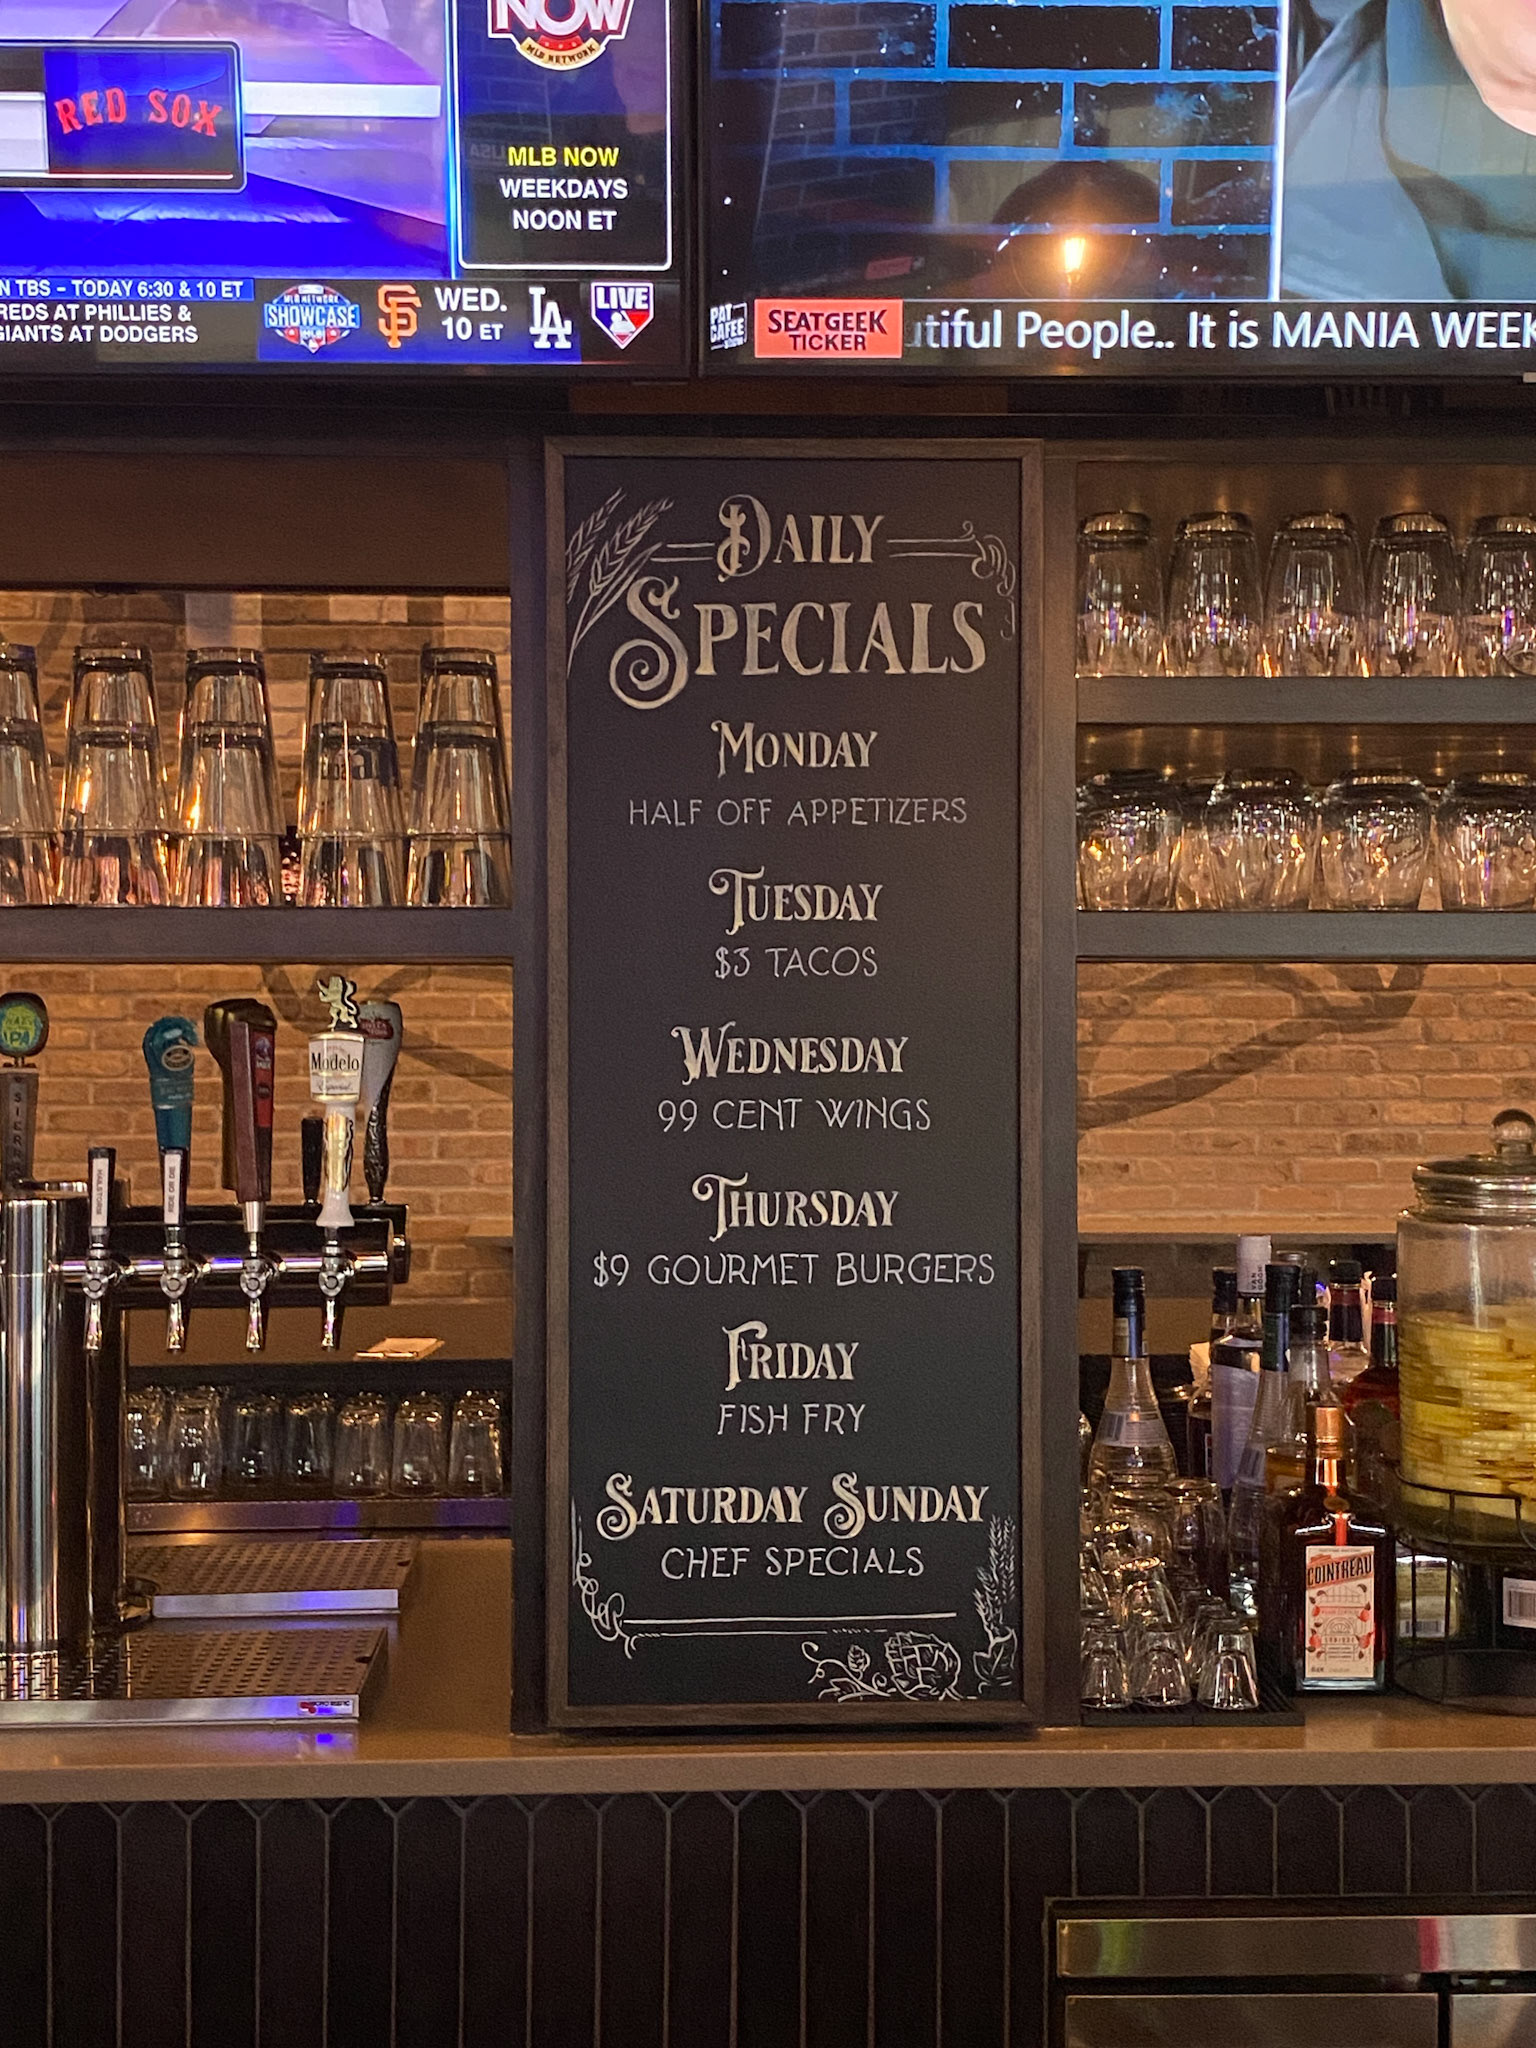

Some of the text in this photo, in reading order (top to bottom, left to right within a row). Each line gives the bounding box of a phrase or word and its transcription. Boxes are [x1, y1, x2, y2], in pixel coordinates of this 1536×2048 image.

[497, 0, 625, 36] NOW
[54, 87, 222, 137] RED SOX
[508, 146, 619, 167] MLB NOW
[499, 178, 628, 199] WEEKDAYS
[512, 209, 617, 230] NOON ET
[15, 279, 51, 297] TBS
[72, 280, 133, 297] TODAY
[137, 280, 174, 297] 6:30
[179, 281, 191, 297] &
[196, 281, 216, 297] 10
[221, 281, 243, 297] ET
[434, 287, 507, 312] WED.
[596, 286, 649, 309] LIVE
[0, 303, 191, 321] REDS AT PHILLIES &
[268, 304, 356, 327] SHOWCASE
[529, 287, 572, 349] LA
[711, 303, 733, 324] PAT
[768, 309, 888, 335] SEATGEEK
[68, 325, 94, 342] AT
[100, 325, 198, 343] DODGERS
[441, 317, 504, 340] 10 ET
[789, 334, 866, 351] TICKER
[1017, 309, 1175, 359] People..
[1188, 311, 1216, 349] It
[1228, 309, 1259, 349] is
[1272, 311, 1420, 349] MANIA
[1430, 311, 1536, 349] WEEK
[717, 494, 885, 582] DAILY
[609, 575, 987, 709] SPECIALS
[711, 720, 878, 778] MONDAY
[629, 797, 967, 827] HALF OFF APPETIZERS
[708, 866, 883, 935] TUESDAY
[715, 946, 878, 980] $3 TACOS
[311, 1052, 359, 1071] Modelo
[671, 1022, 909, 1085] WEDNESDAY
[658, 1097, 931, 1132] 99 CENT WINGS
[692, 1172, 899, 1242] THURSDAY
[594, 1251, 995, 1287] $9 GOURMET BURGERS
[722, 1320, 859, 1391] FRIDAY
[718, 1403, 866, 1435] FISH FRY
[596, 1472, 990, 1541] SATURDAY SUNDAY
[661, 1547, 924, 1579] CHEF SPECIALS
[1307, 1554, 1372, 1586] COINTREAU
